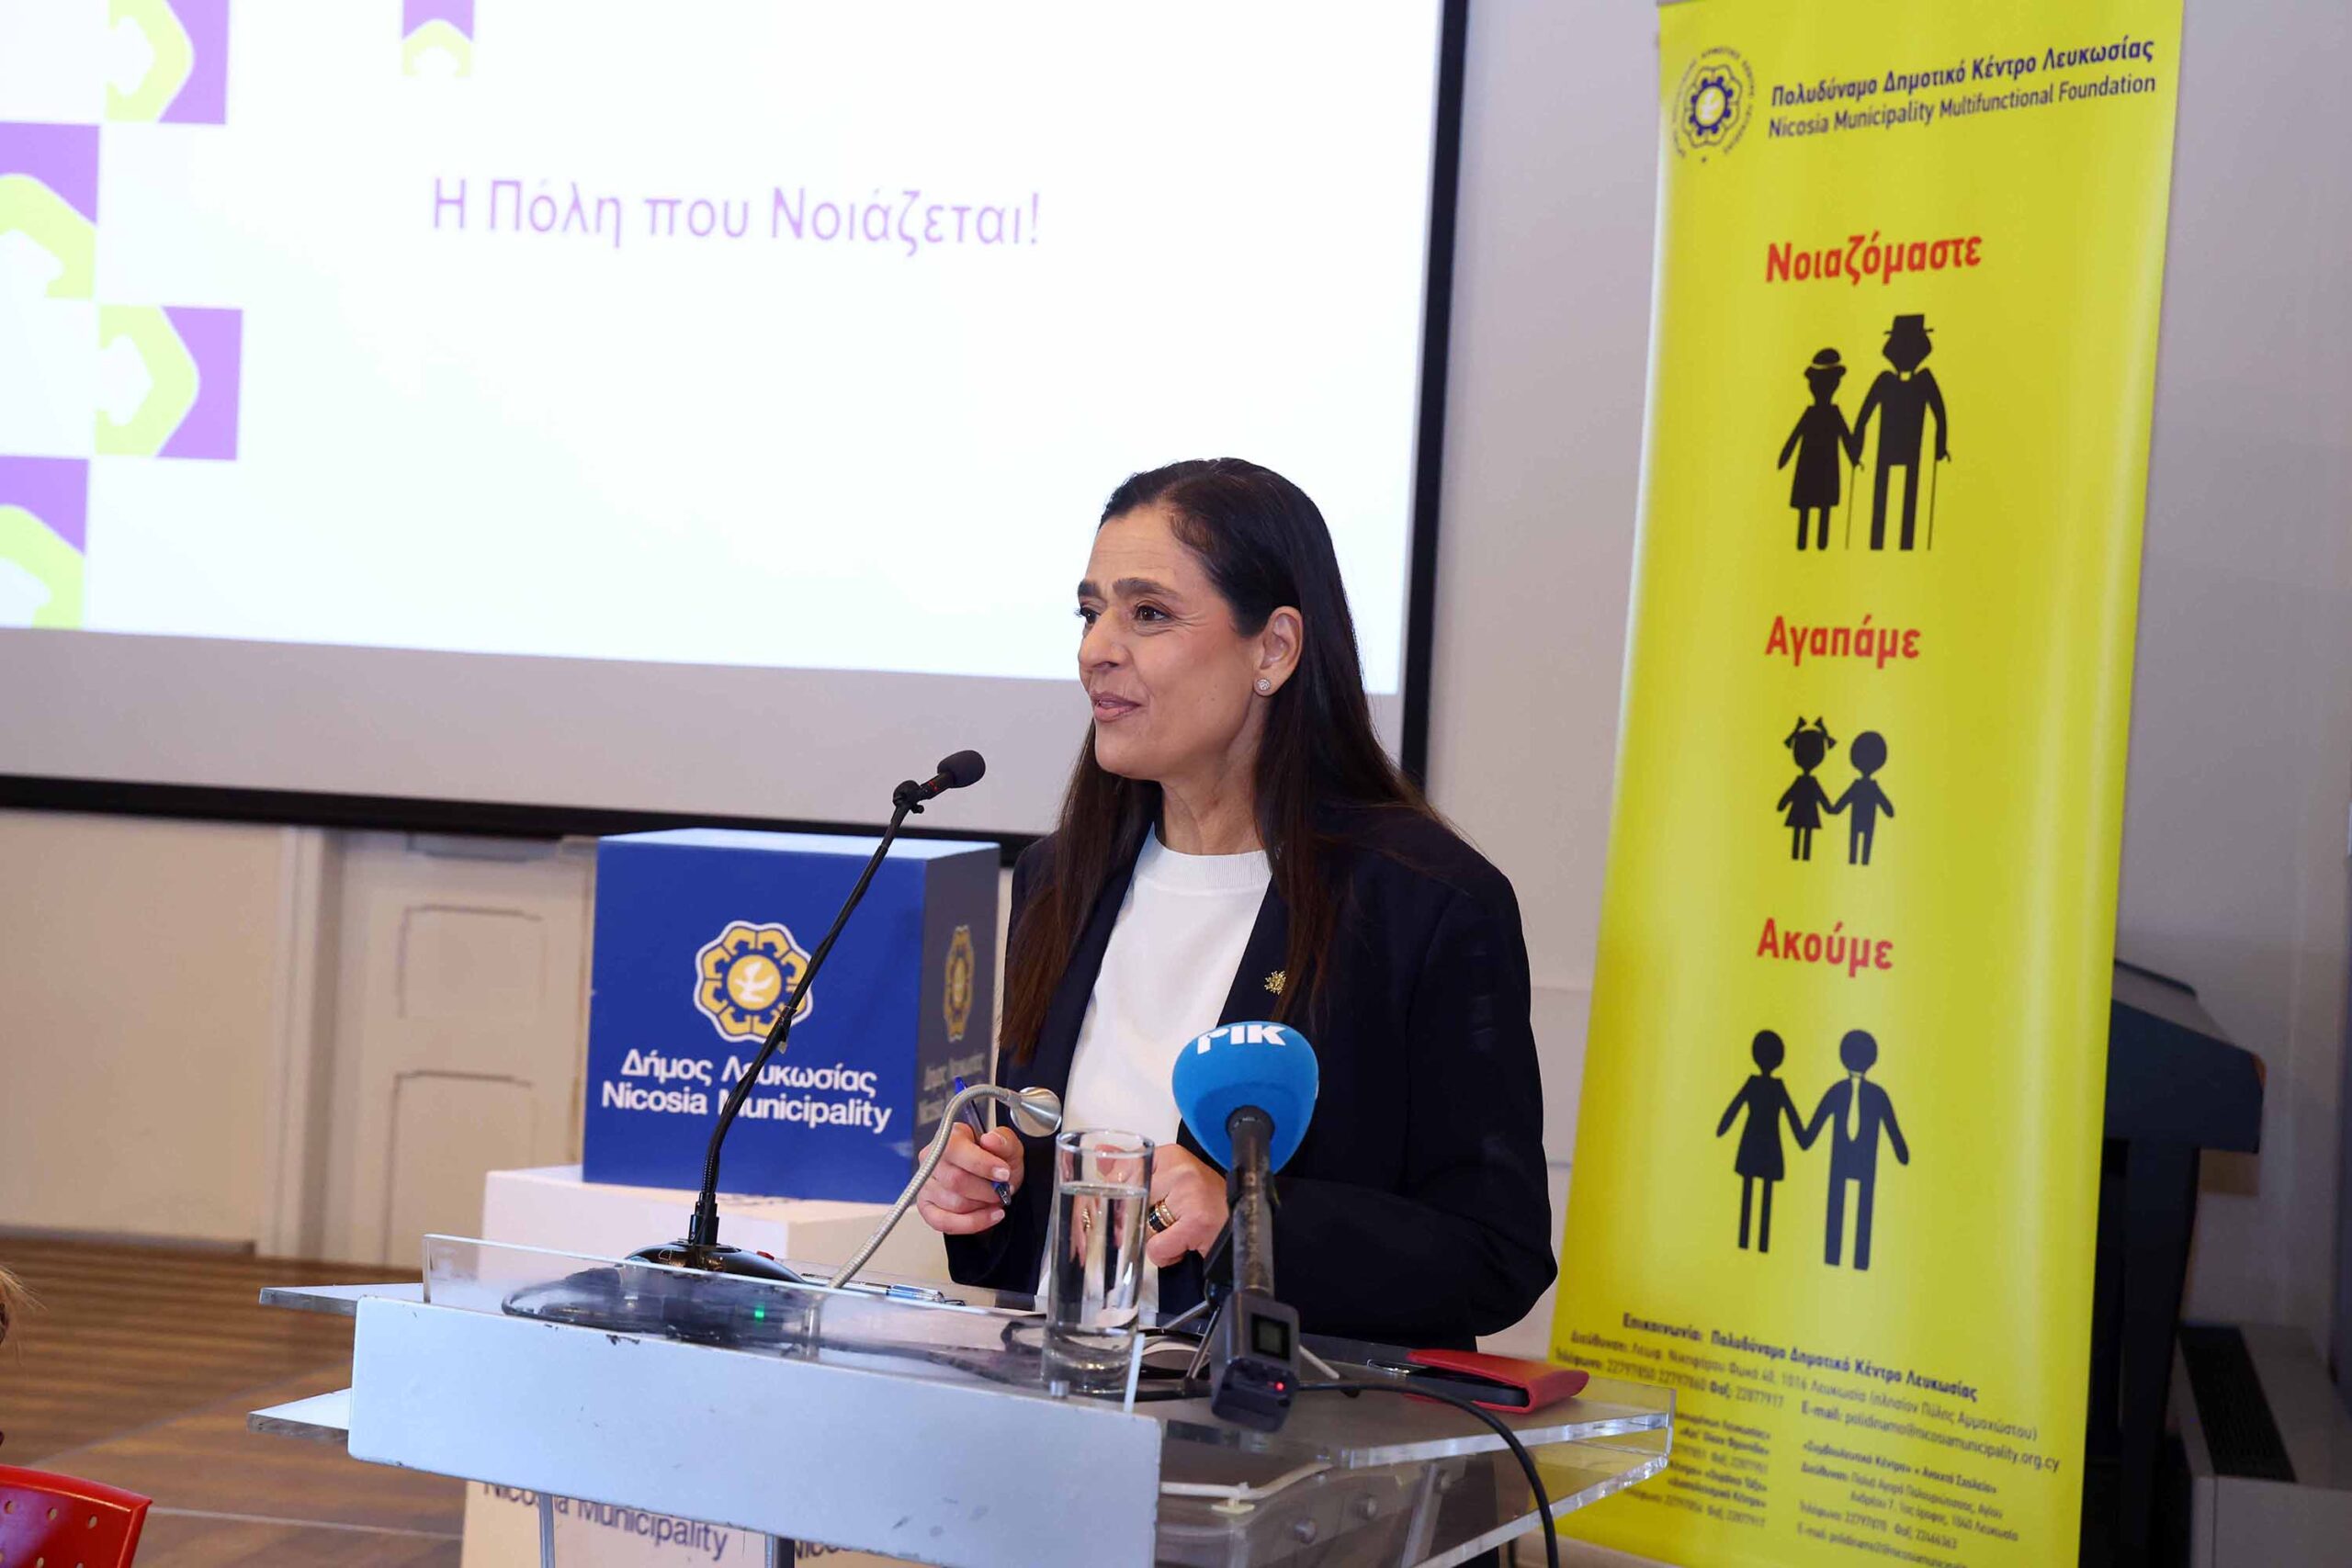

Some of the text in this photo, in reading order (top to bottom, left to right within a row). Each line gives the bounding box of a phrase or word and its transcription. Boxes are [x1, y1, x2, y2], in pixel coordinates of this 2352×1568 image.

[1771, 35, 2154, 107] Πολυδύναμο Δημοτικό Κέντρο Λευκωσίας
[1769, 74, 2155, 139] Nicosia Municipality Multifunctional Foundation
[434, 178, 1039, 257] Η Πόλη που Νοιάζεται!
[1765, 230, 1983, 287] Νοιαζόμαστε
[1765, 614, 1921, 670] Αγαπάμε
[1757, 917, 1894, 978] Ακούμε
[602, 1080, 707, 1115] Nicosia
[621, 1048, 713, 1086] Δήμος
[1710, 1329, 1787, 1361] Πολυδύναμο
[1790, 1346, 1850, 1373] Δημοτικό
[1855, 1359, 1902, 1385] Κέντρο
[1906, 1370, 1978, 1403] Λευκωσίας
